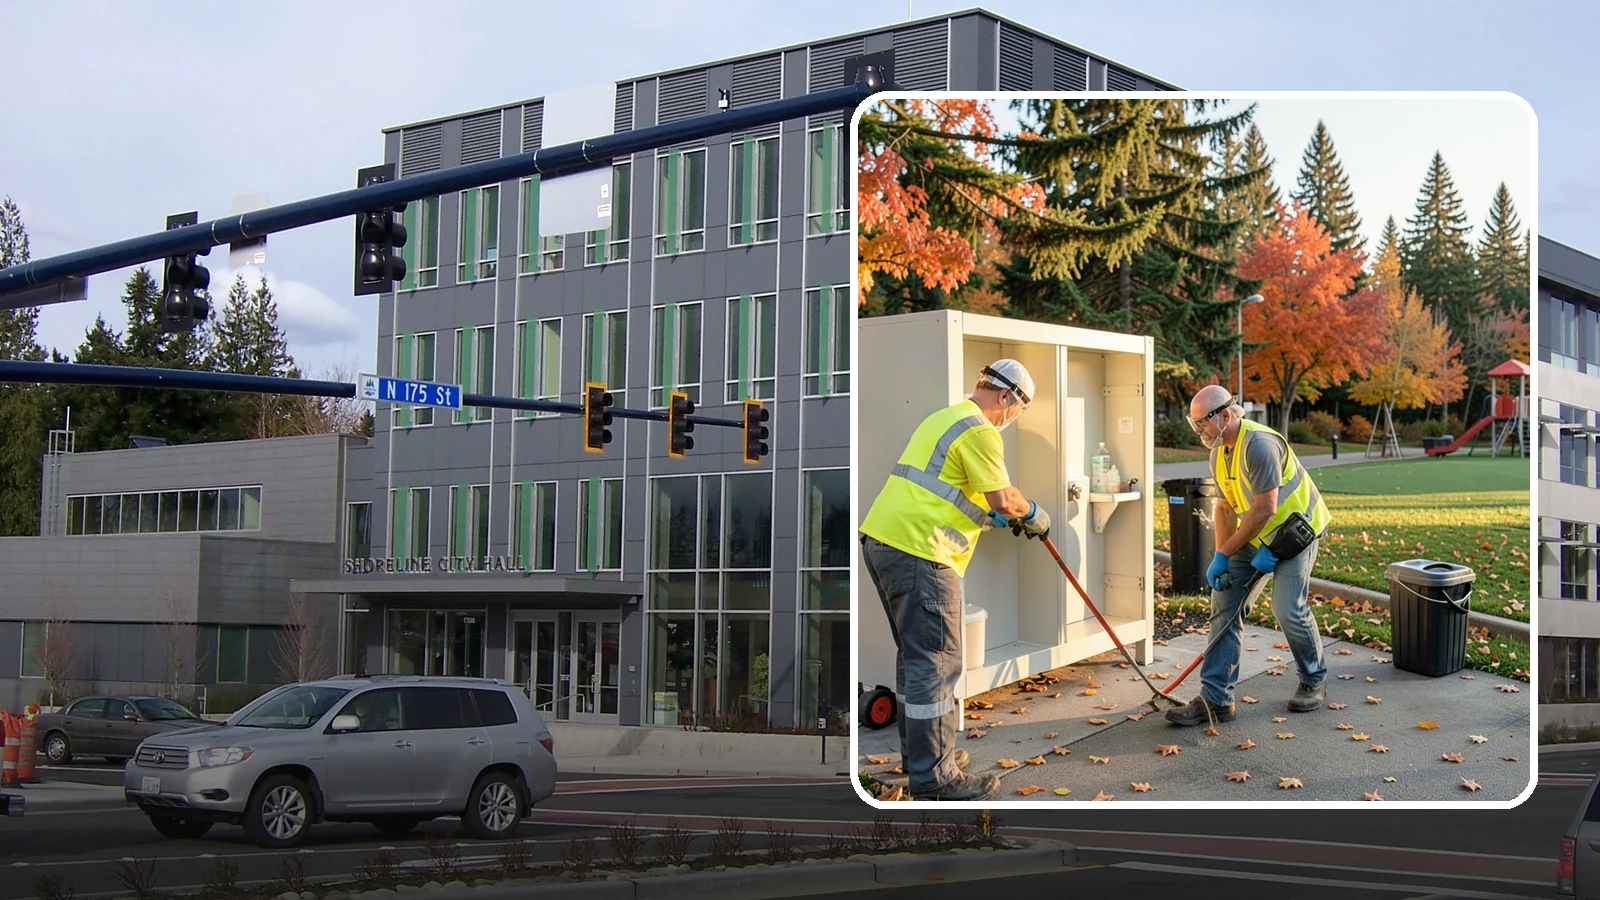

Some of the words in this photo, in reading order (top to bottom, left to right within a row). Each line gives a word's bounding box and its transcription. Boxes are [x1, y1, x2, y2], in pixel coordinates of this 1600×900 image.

[387, 380, 396, 399] N
[405, 382, 427, 403] 175
[436, 386, 451, 406] St
[343, 557, 432, 573] SHORELINE
[438, 556, 476, 572] CITY
[483, 556, 525, 572] HALL
